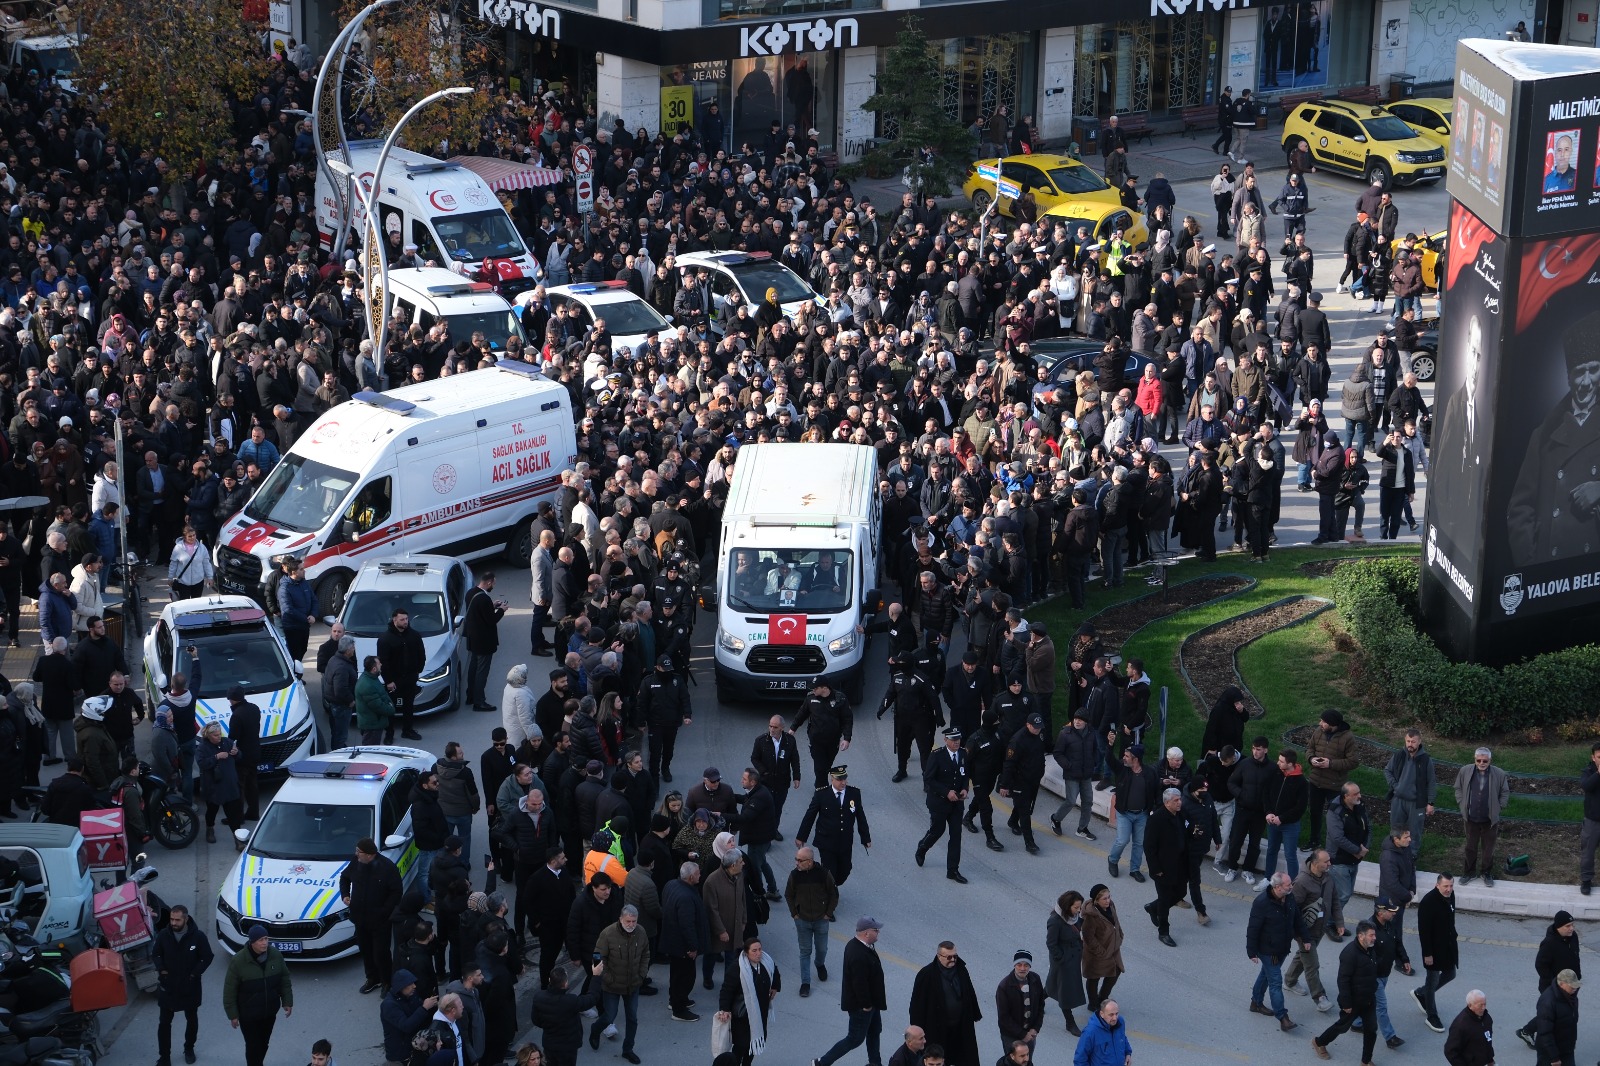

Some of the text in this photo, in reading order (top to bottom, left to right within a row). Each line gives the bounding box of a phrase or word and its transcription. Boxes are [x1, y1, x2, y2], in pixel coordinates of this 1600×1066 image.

[740, 18, 859, 57] KOTON
[693, 68, 727, 81] JEANS
[512, 422, 526, 435] T.C.
[492, 434, 547, 459] SAĞLIK BAKANLIĞI
[516, 450, 552, 477] SAĞLIK
[420, 497, 483, 525] AMBULANS
[1435, 546, 1474, 603] YALOVA BELEDİYESİ
[1527, 571, 1600, 600] YALOVA BELE
[748, 632, 825, 643] CENA RACI
[769, 681, 778, 689] 77
[250, 875, 336, 888] TRAFİK POLİSİ
[278, 943, 299, 951] 3326
